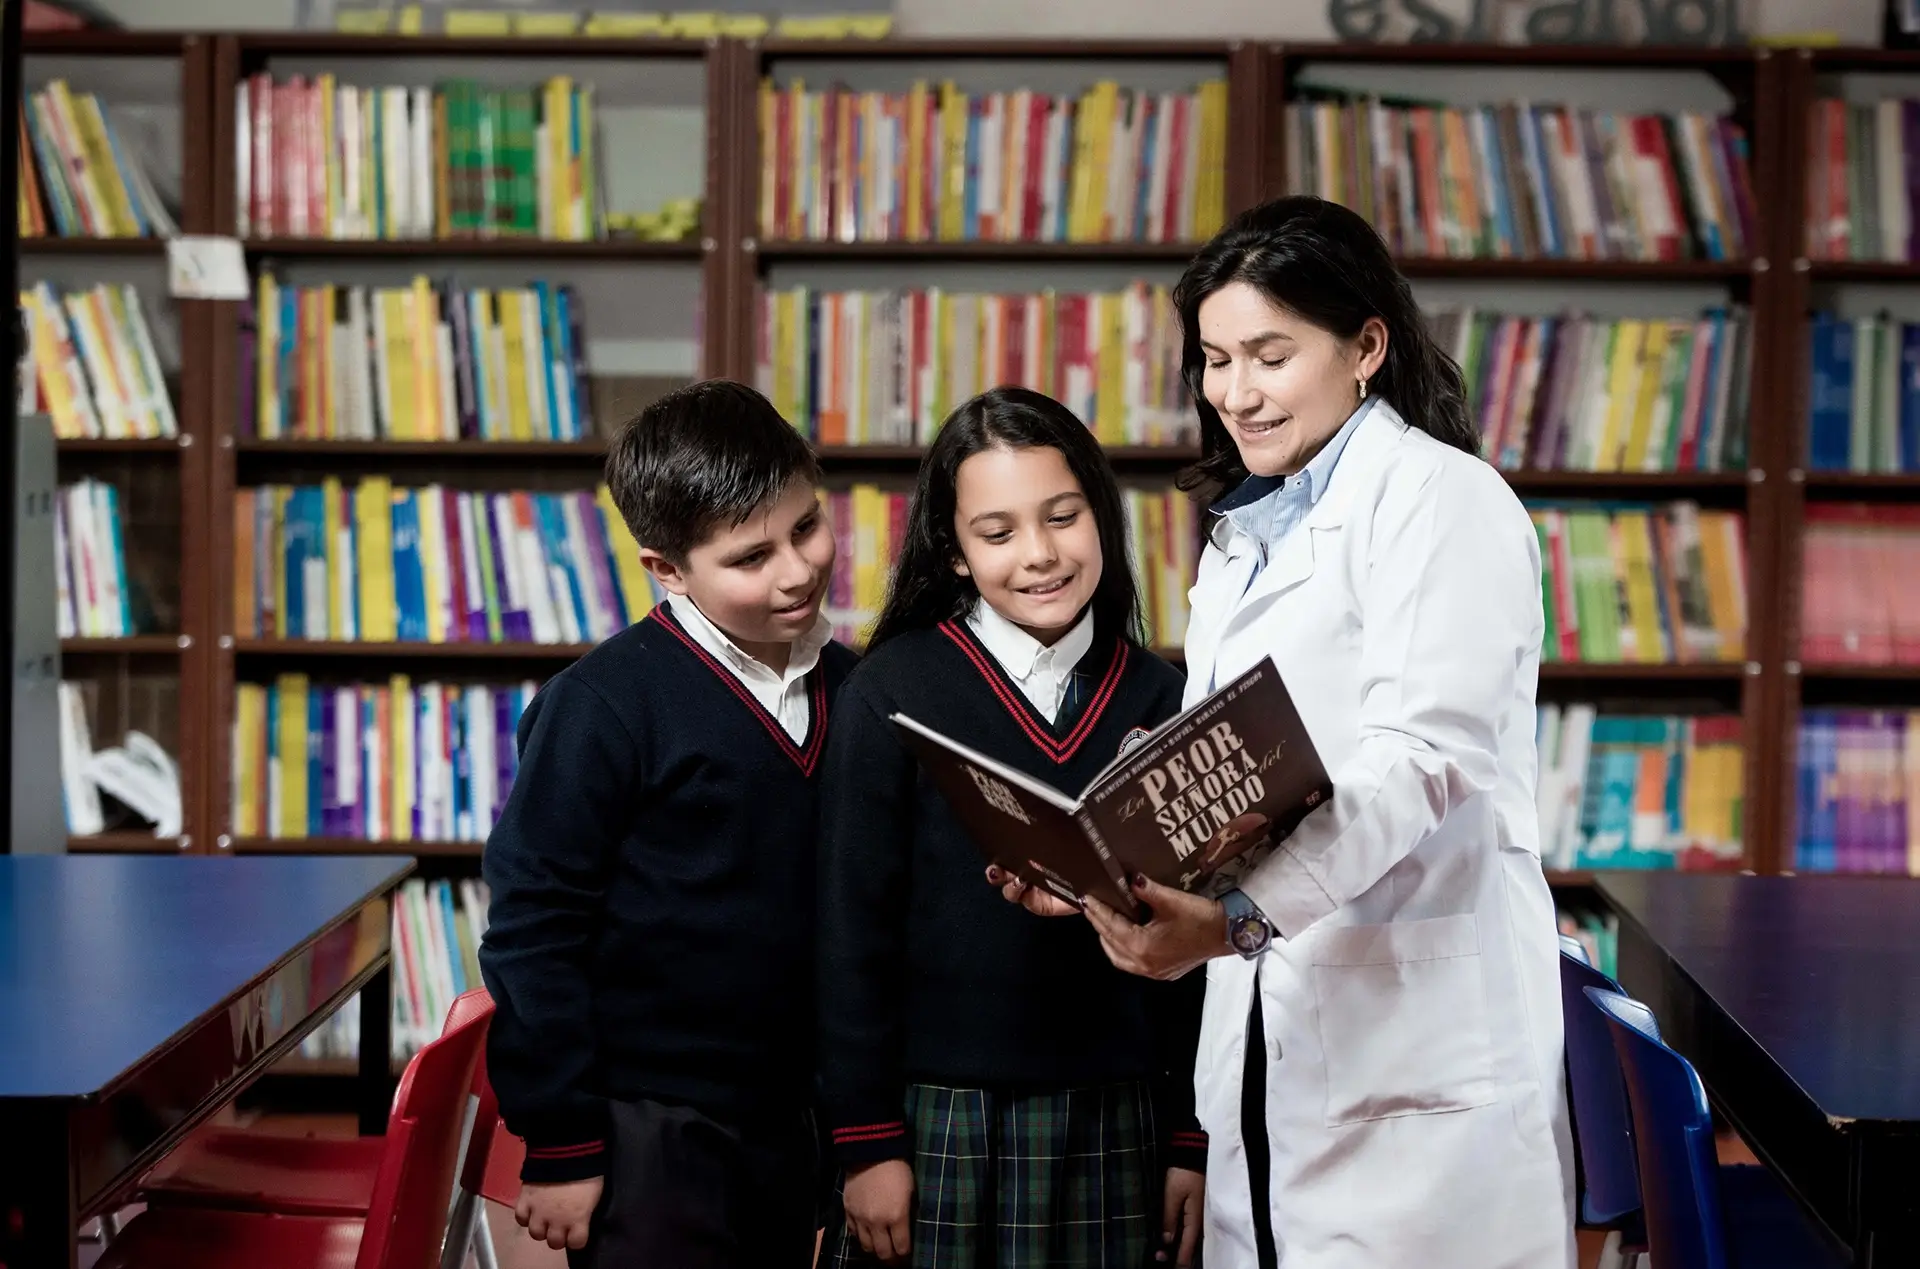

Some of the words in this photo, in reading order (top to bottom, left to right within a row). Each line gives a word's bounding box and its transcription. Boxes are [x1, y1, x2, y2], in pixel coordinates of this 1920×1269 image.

[1117, 797, 1146, 823] La
[1139, 721, 1244, 811] PEOR
[1156, 748, 1258, 837] SEÑORA
[1257, 740, 1287, 774] del
[1168, 774, 1265, 861] MUNDO
